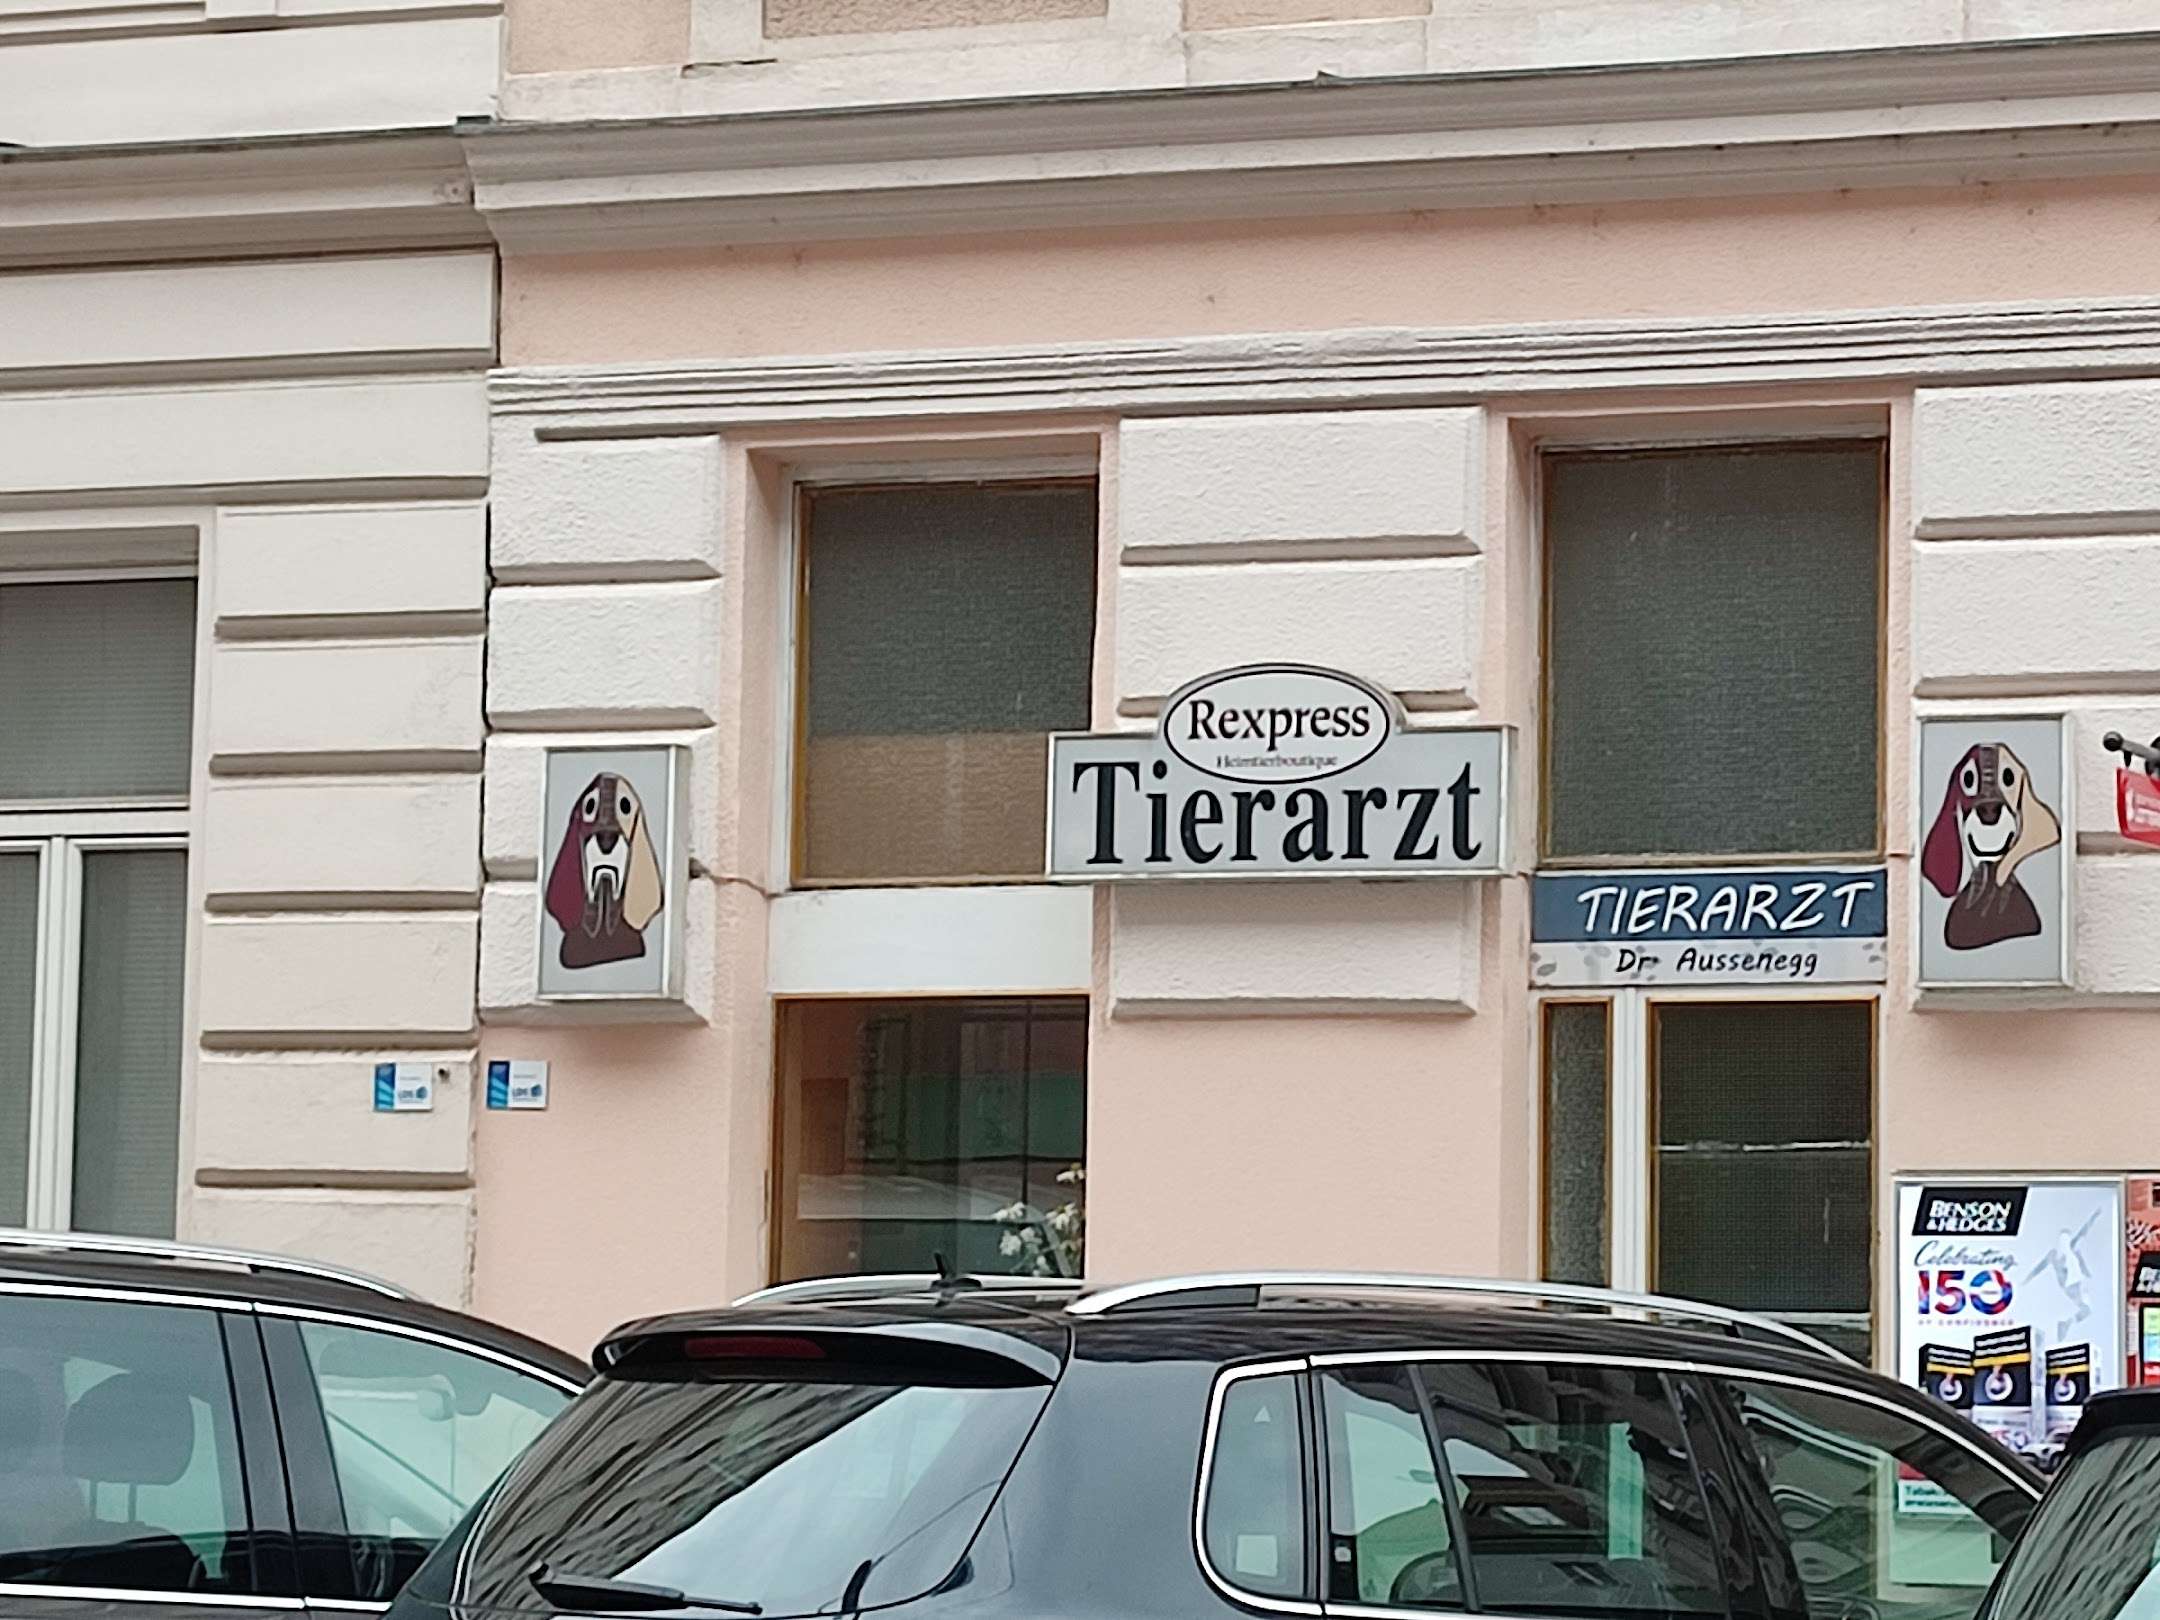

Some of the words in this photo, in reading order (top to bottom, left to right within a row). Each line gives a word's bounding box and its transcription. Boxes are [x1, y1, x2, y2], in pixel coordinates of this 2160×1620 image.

[1188, 700, 1370, 751] Rexpress
[1073, 760, 1482, 864] Tierarzt
[1577, 881, 1876, 934] TIERARZT
[1676, 948, 1818, 976] Aussenegg
[1929, 1200, 2012, 1218] BENSON
[1914, 1240, 2018, 1271] Celebrating
[1918, 1270, 2013, 1315] 150
